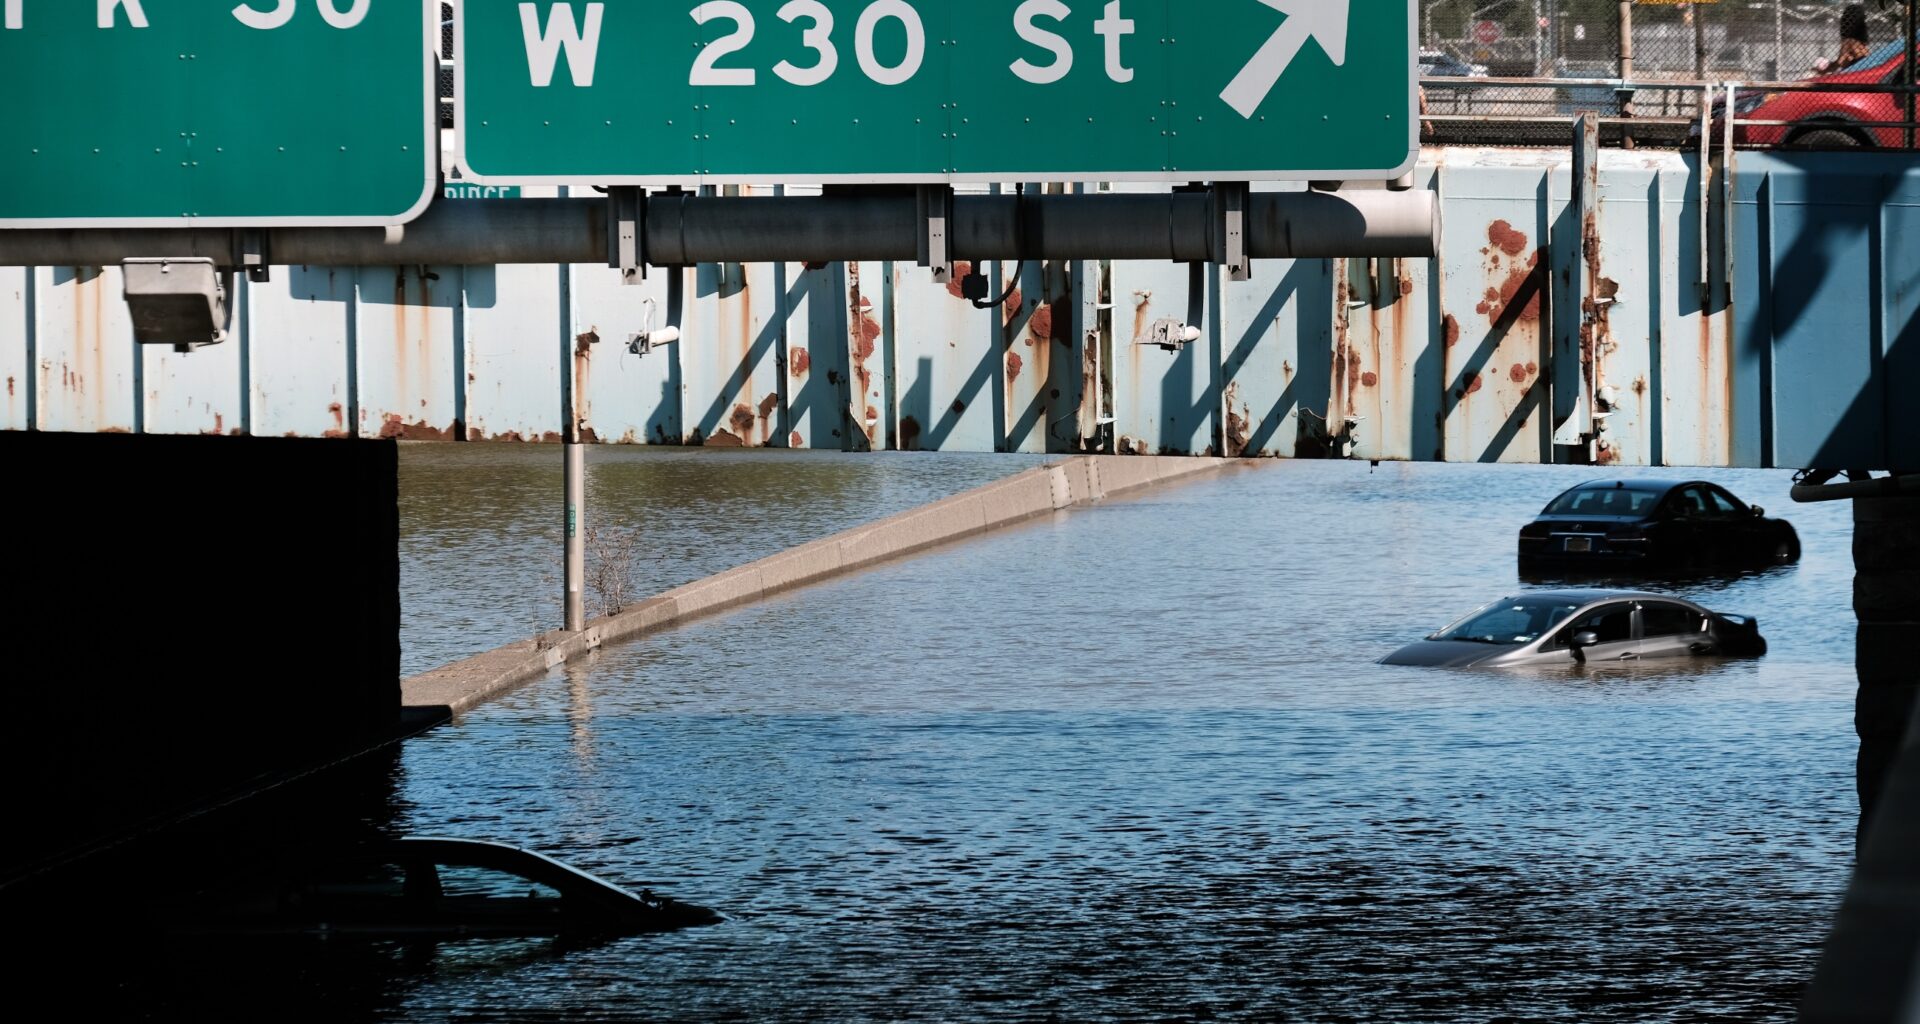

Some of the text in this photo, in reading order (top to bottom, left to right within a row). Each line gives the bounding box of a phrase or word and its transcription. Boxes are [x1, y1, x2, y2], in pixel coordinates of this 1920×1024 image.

[518, 0, 1135, 87] W 230 St
